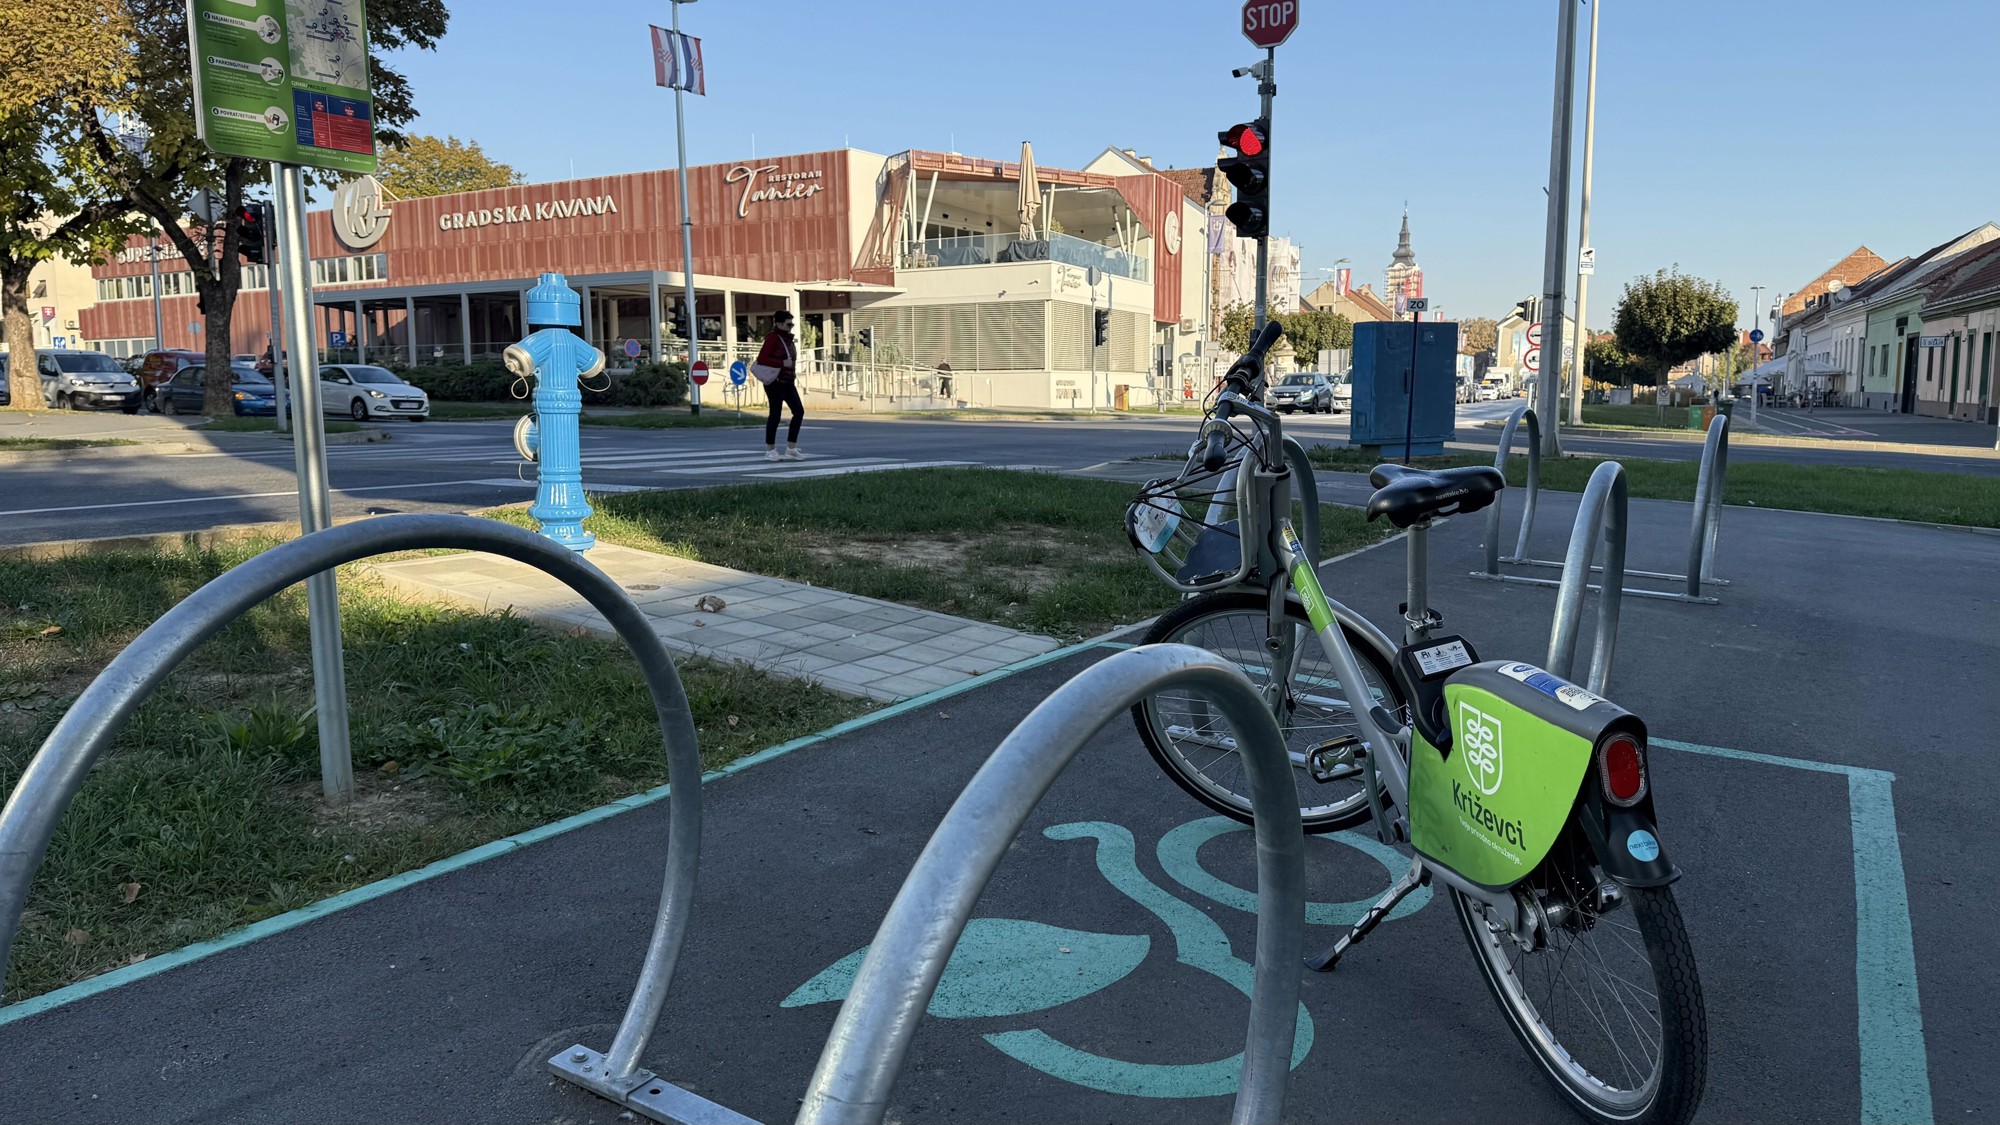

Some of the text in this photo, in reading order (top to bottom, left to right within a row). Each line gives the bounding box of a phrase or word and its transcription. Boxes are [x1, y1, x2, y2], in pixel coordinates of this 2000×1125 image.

[1246, 1, 1293, 31] STOP
[767, 170, 823, 183] RESTORAN
[439, 194, 618, 231] GRADSKA KAVANA
[1410, 300, 1424, 309] ZO
[1435, 489, 1460, 500] nextbike
[1452, 778, 1527, 851] Križevci
[1629, 839, 1656, 850] nextbike
